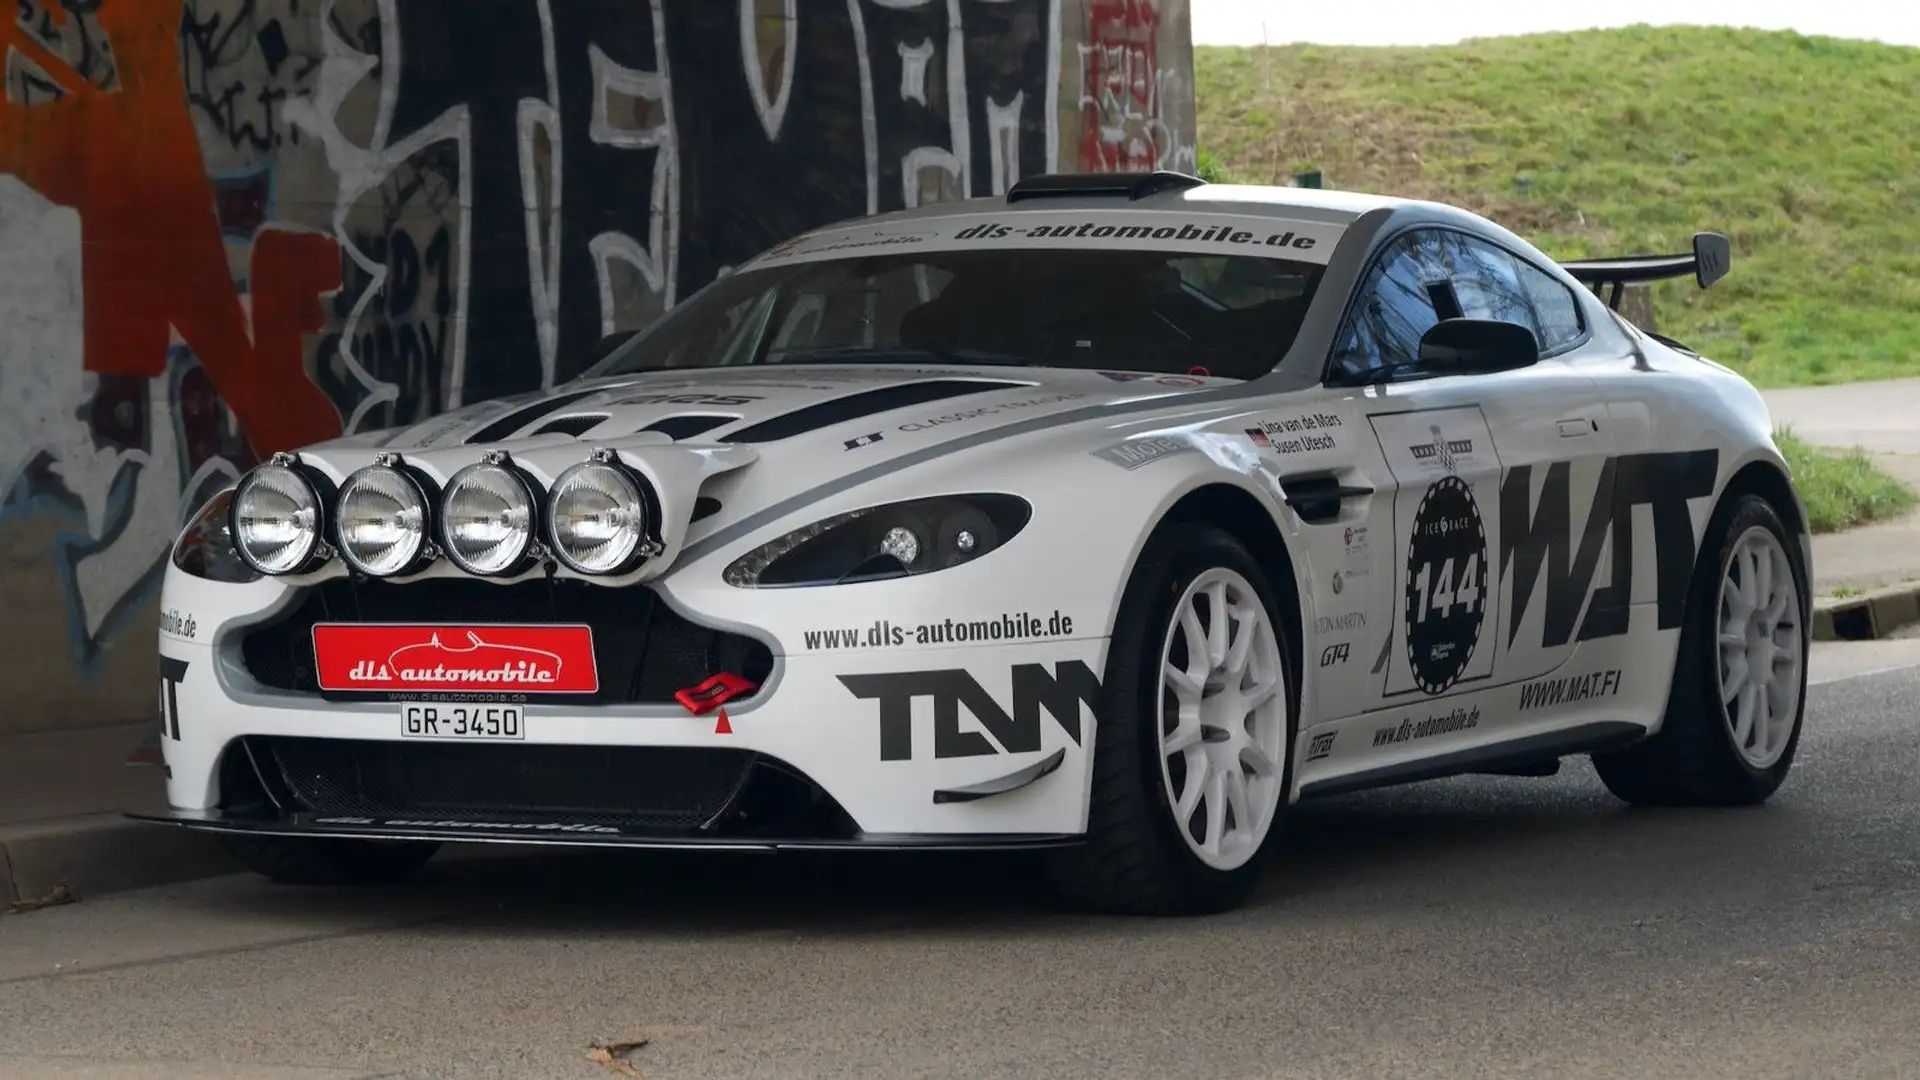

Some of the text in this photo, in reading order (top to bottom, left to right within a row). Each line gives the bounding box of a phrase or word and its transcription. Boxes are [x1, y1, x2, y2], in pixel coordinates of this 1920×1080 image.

[954, 223, 1317, 250] dls-automobile.de
[1282, 418, 1303, 432] van
[1302, 414, 1315, 430] de
[1313, 413, 1342, 429] Mars
[1271, 433, 1336, 454] Susen Utesch
[1424, 521, 1439, 535] ICE
[1414, 553, 1480, 624] 144
[804, 610, 1074, 650] www.dls-automobile.de
[1320, 643, 1350, 668] GT4
[349, 660, 556, 683] dls automobile
[1519, 670, 1623, 711] WWW.MAT.FI
[407, 707, 518, 737] GR-3450
[1372, 704, 1481, 747] www.dls-automobile.de
